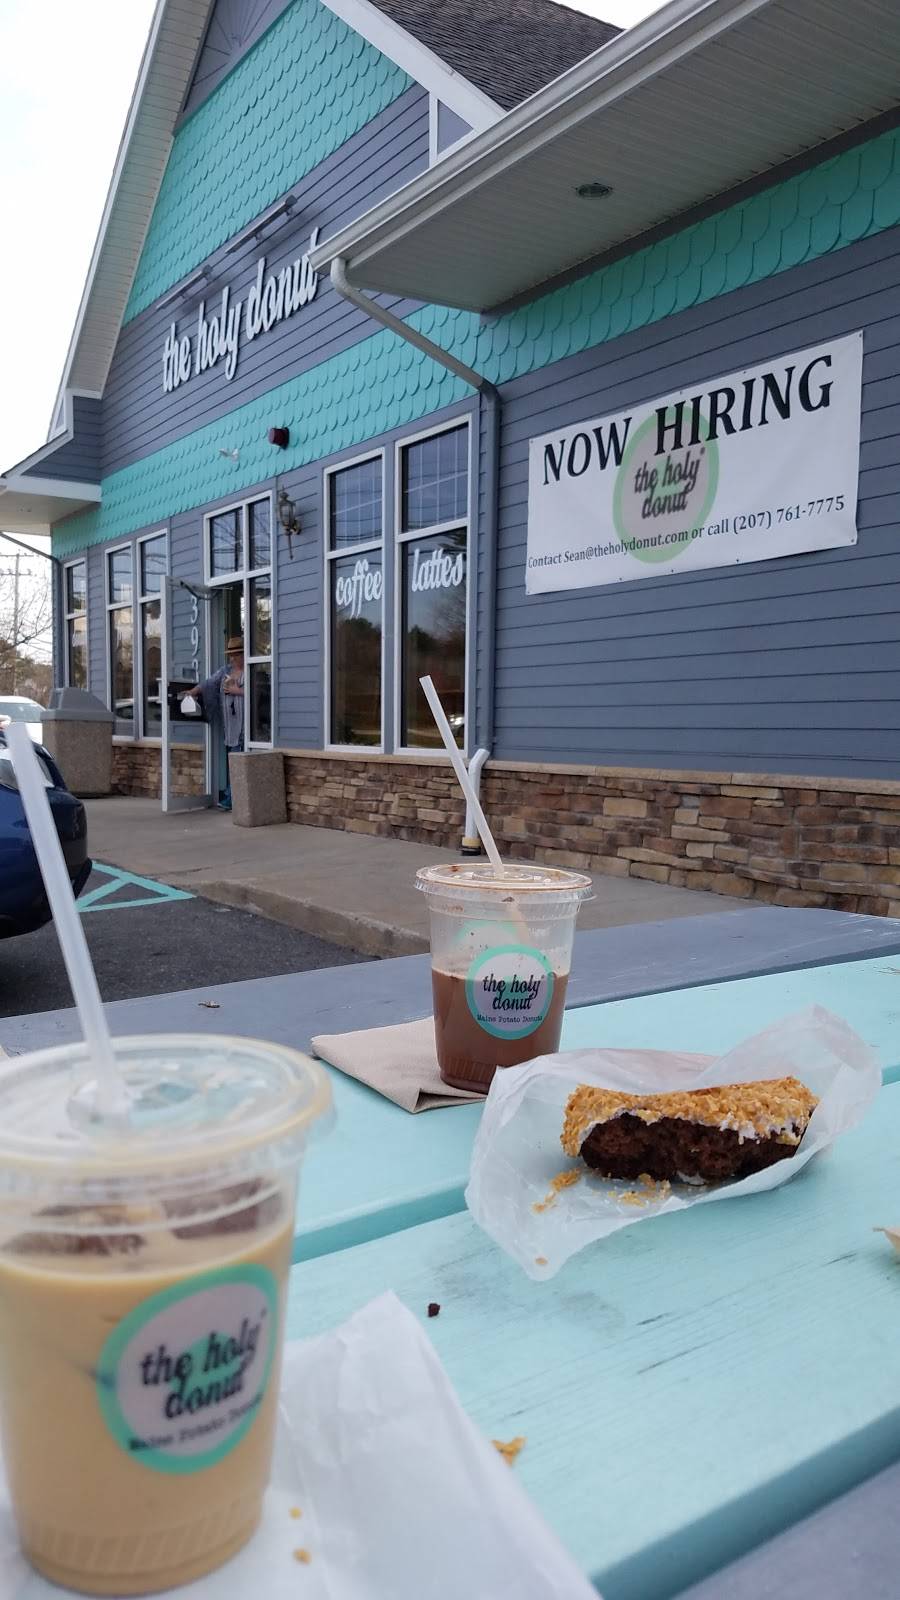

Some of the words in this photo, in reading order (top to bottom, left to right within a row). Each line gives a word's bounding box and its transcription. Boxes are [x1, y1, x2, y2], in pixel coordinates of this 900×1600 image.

[163, 321, 191, 392] the
[195, 286, 242, 380] holy
[246, 227, 319, 340] donut
[543, 417, 632, 485] NOW
[654, 355, 833, 455] HIRING
[634, 460, 659, 494] the
[662, 450, 701, 494] holy
[641, 488, 689, 519] donut
[528, 553, 562, 568] Contact
[564, 529, 688, 562] Sean@theholydonut.com
[691, 526, 705, 540] or
[707, 518, 729, 535] call
[734, 510, 772, 535] (207)
[777, 494, 845, 524] 761-7775
[335, 558, 384, 618] coffee
[412, 547, 463, 592] lattes
[482, 973, 507, 995] the
[510, 973, 542, 999] holy
[492, 993, 533, 1011] donut
[141, 1344, 193, 1391] the
[203, 1317, 260, 1380] holy
